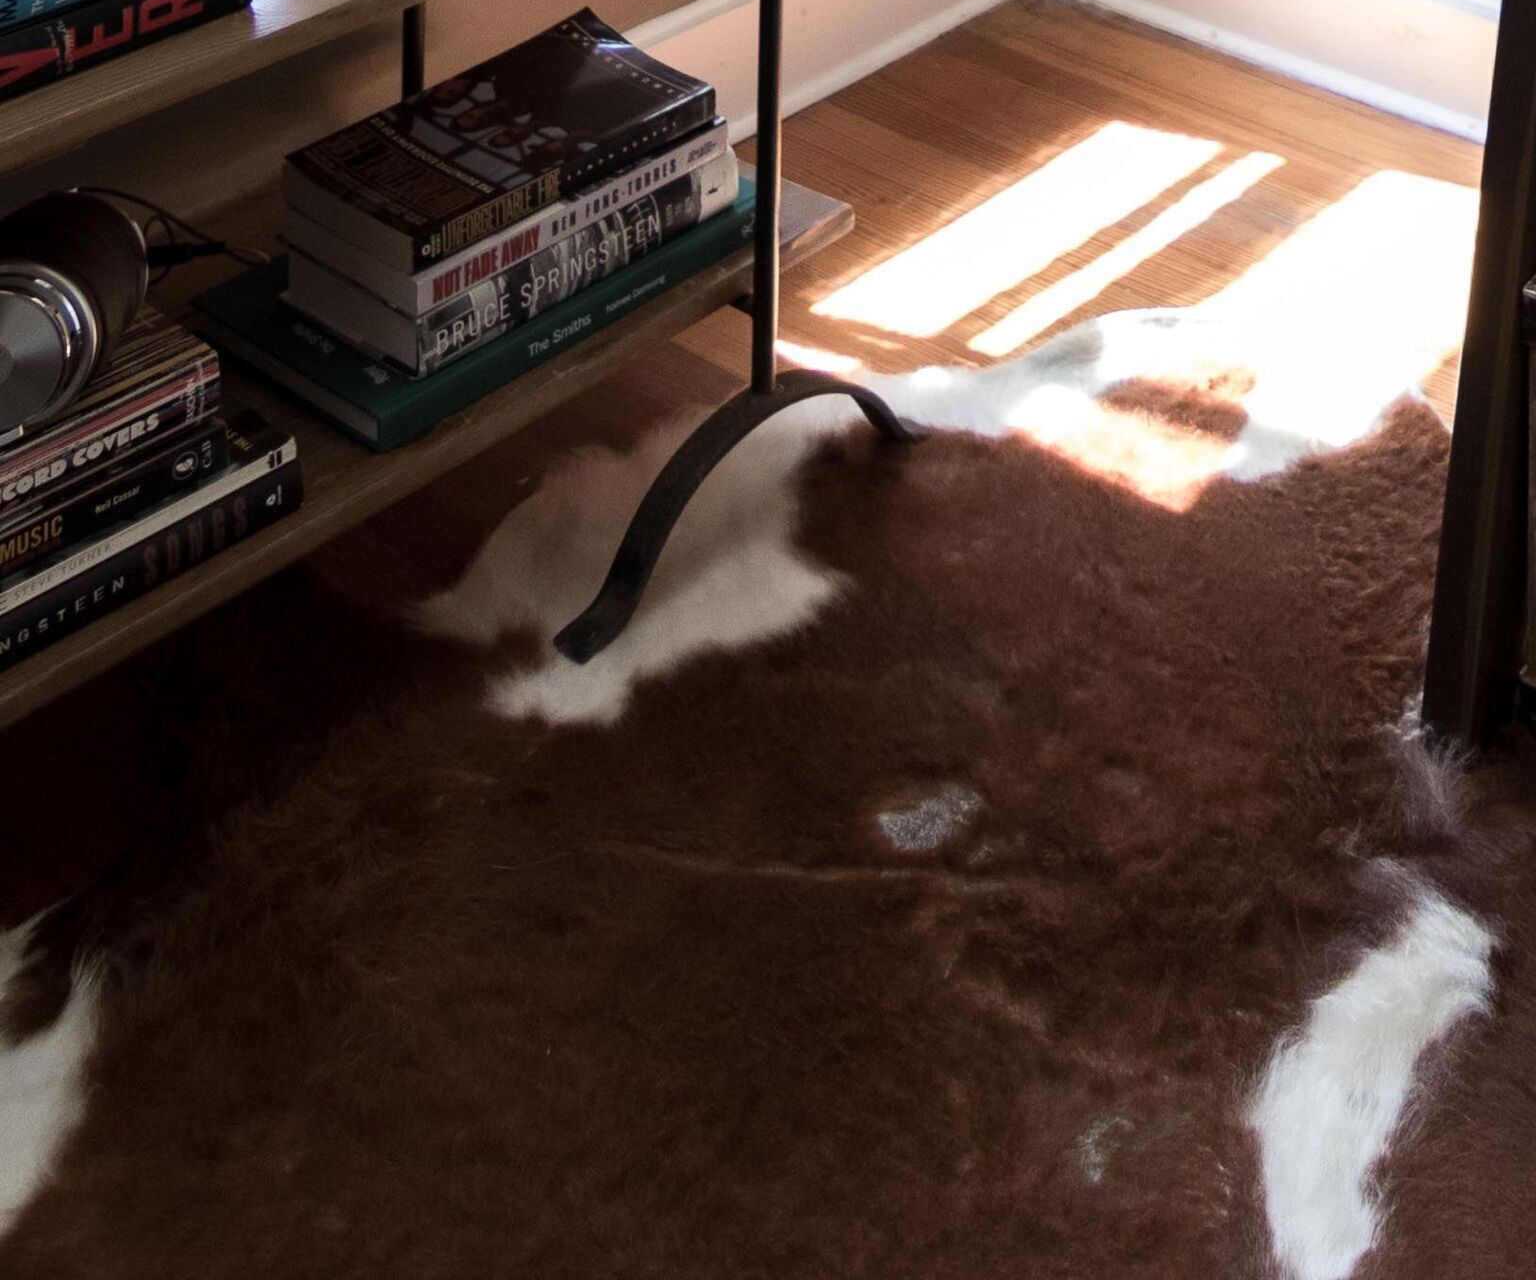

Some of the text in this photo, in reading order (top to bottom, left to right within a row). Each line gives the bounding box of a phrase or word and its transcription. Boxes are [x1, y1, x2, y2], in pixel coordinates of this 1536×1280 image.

[442, 186, 530, 253] UNFORGETTABLE
[431, 269, 463, 304] NOT
[464, 243, 499, 288] FADE
[501, 224, 541, 269] AWAY
[551, 211, 577, 237] BEN
[435, 214, 660, 355] BRUCE SPRINGSTEEN
[528, 338, 549, 357] The
[552, 313, 592, 344] Smiths
[72, 412, 160, 467] COVERS
[0, 514, 64, 566] MUSIC
